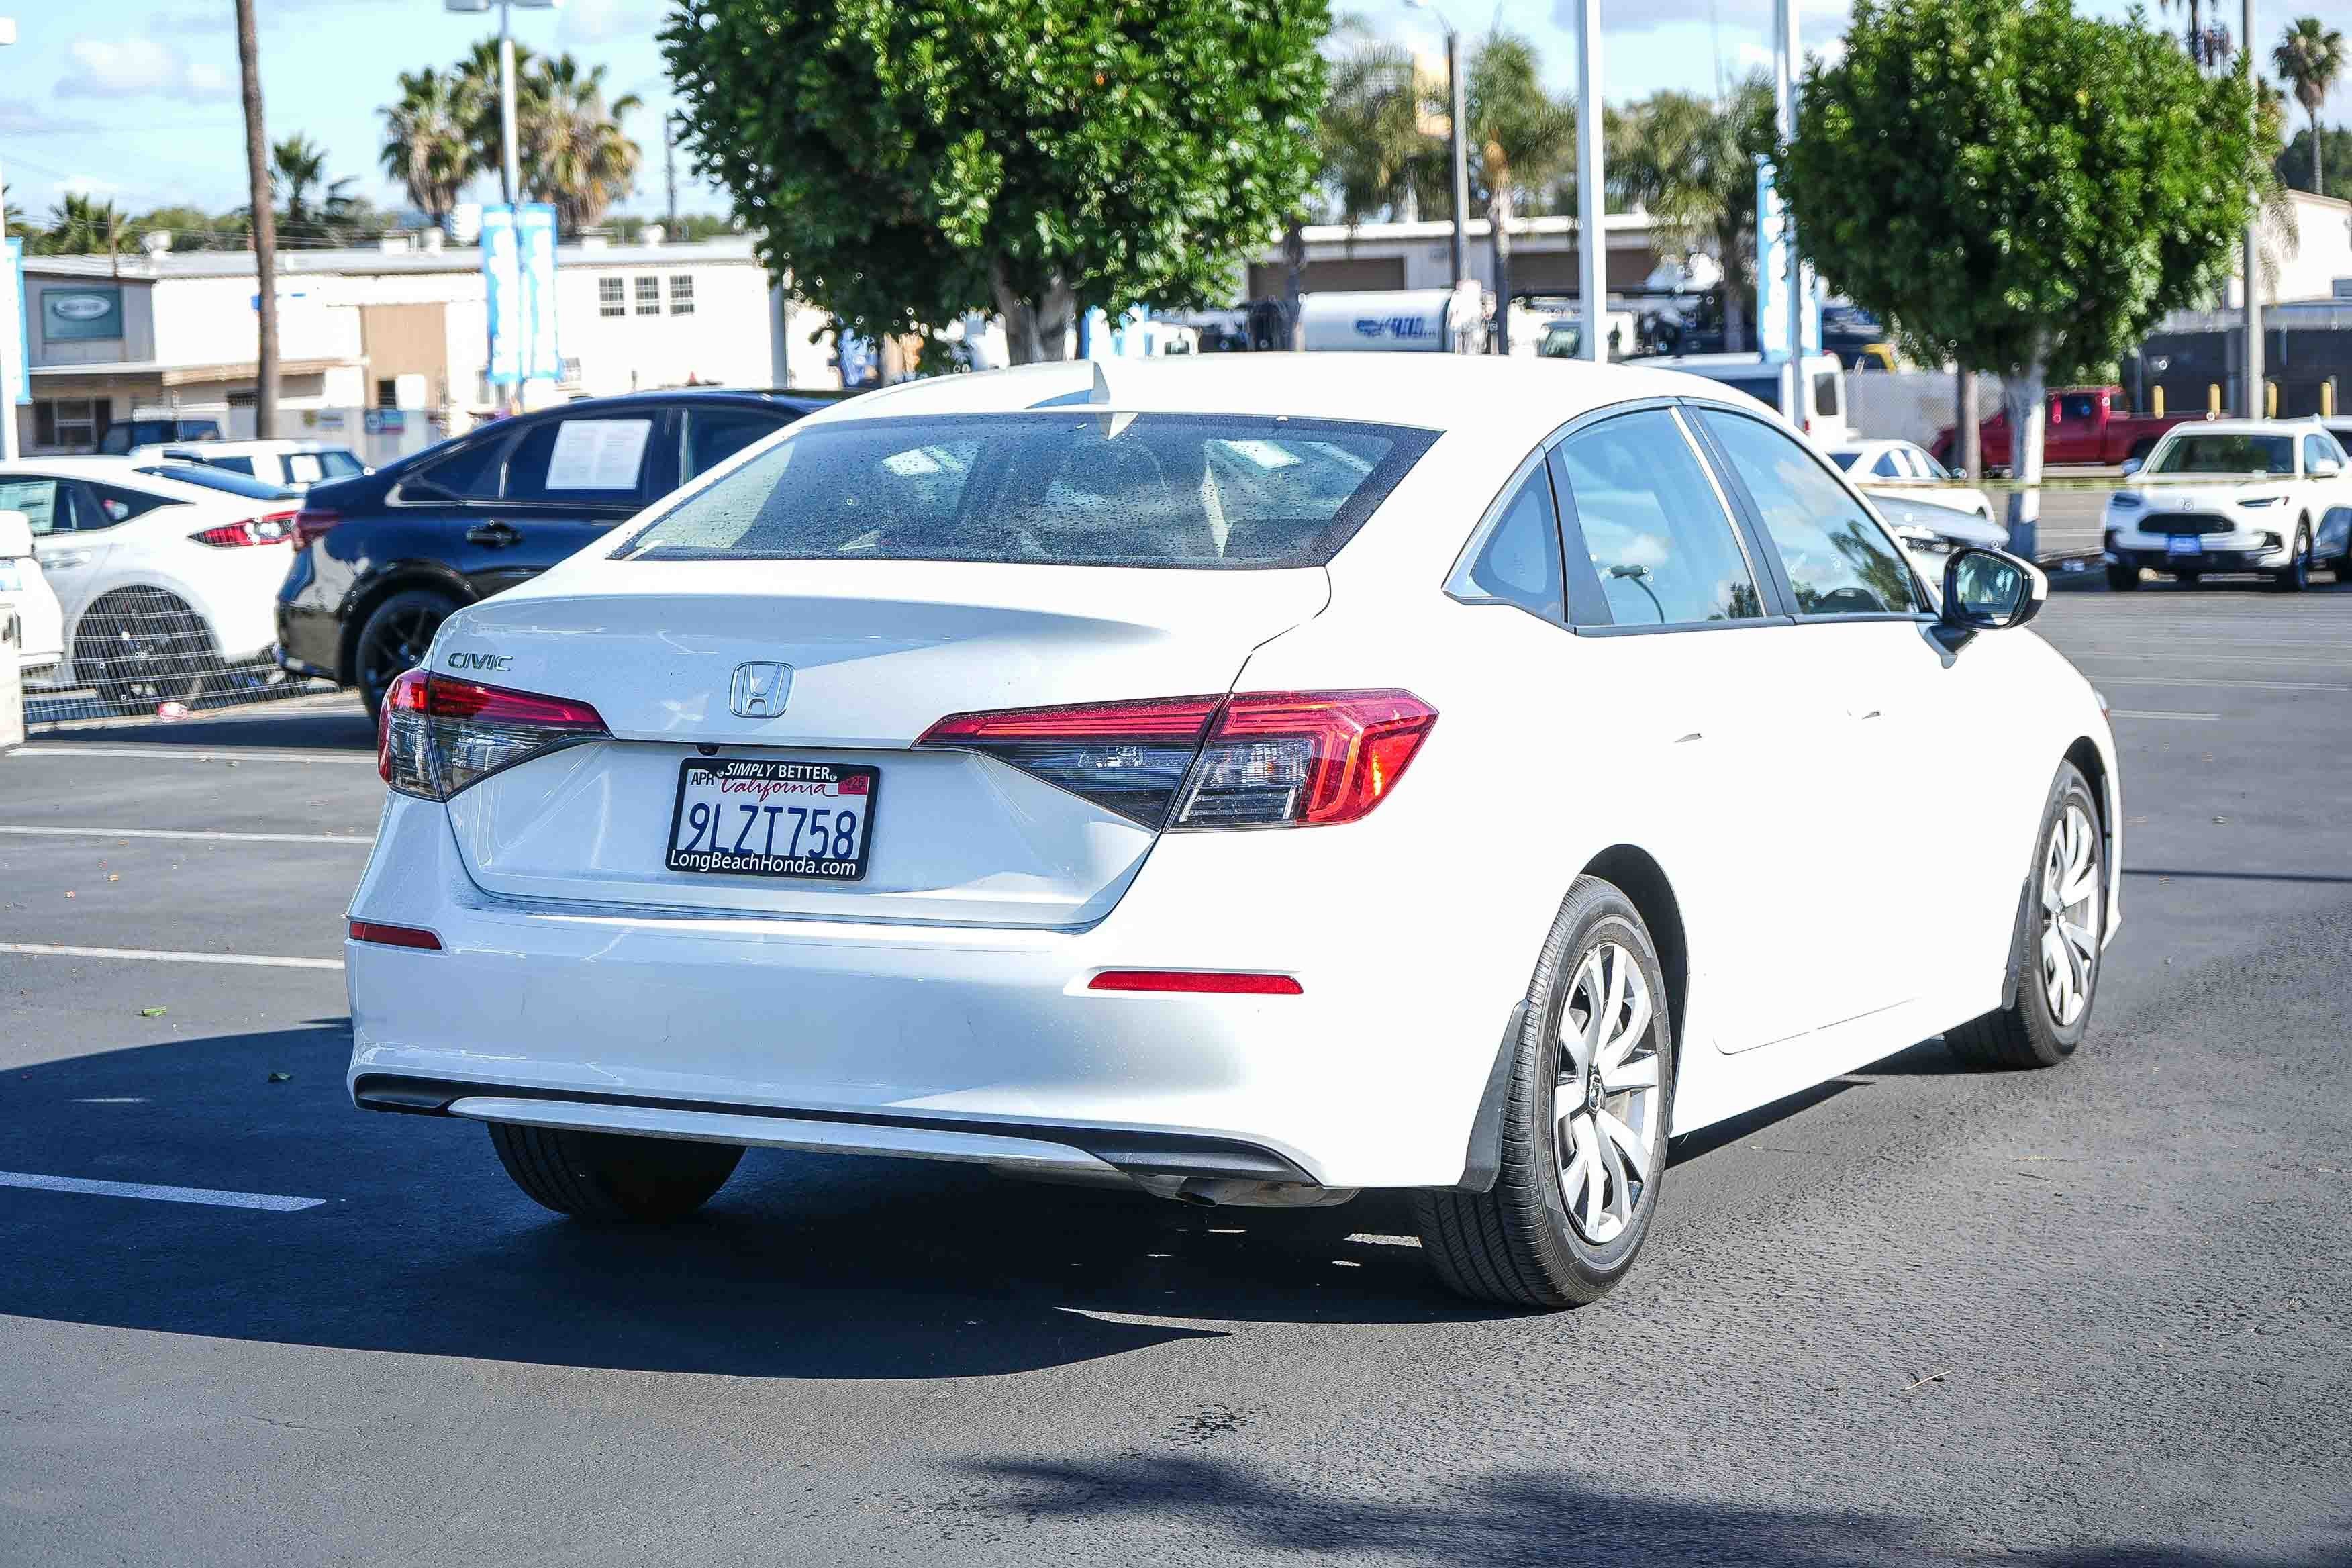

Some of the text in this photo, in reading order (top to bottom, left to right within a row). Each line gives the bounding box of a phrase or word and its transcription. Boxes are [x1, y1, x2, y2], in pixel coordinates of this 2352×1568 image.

[448, 652, 513, 671] CIVIC
[691, 771, 714, 786] APR
[724, 763, 830, 781] SIMPLY BETTER
[720, 778, 838, 802] California
[684, 802, 857, 860] 9LZT758
[670, 849, 856, 876] LongBeachHonda.com
